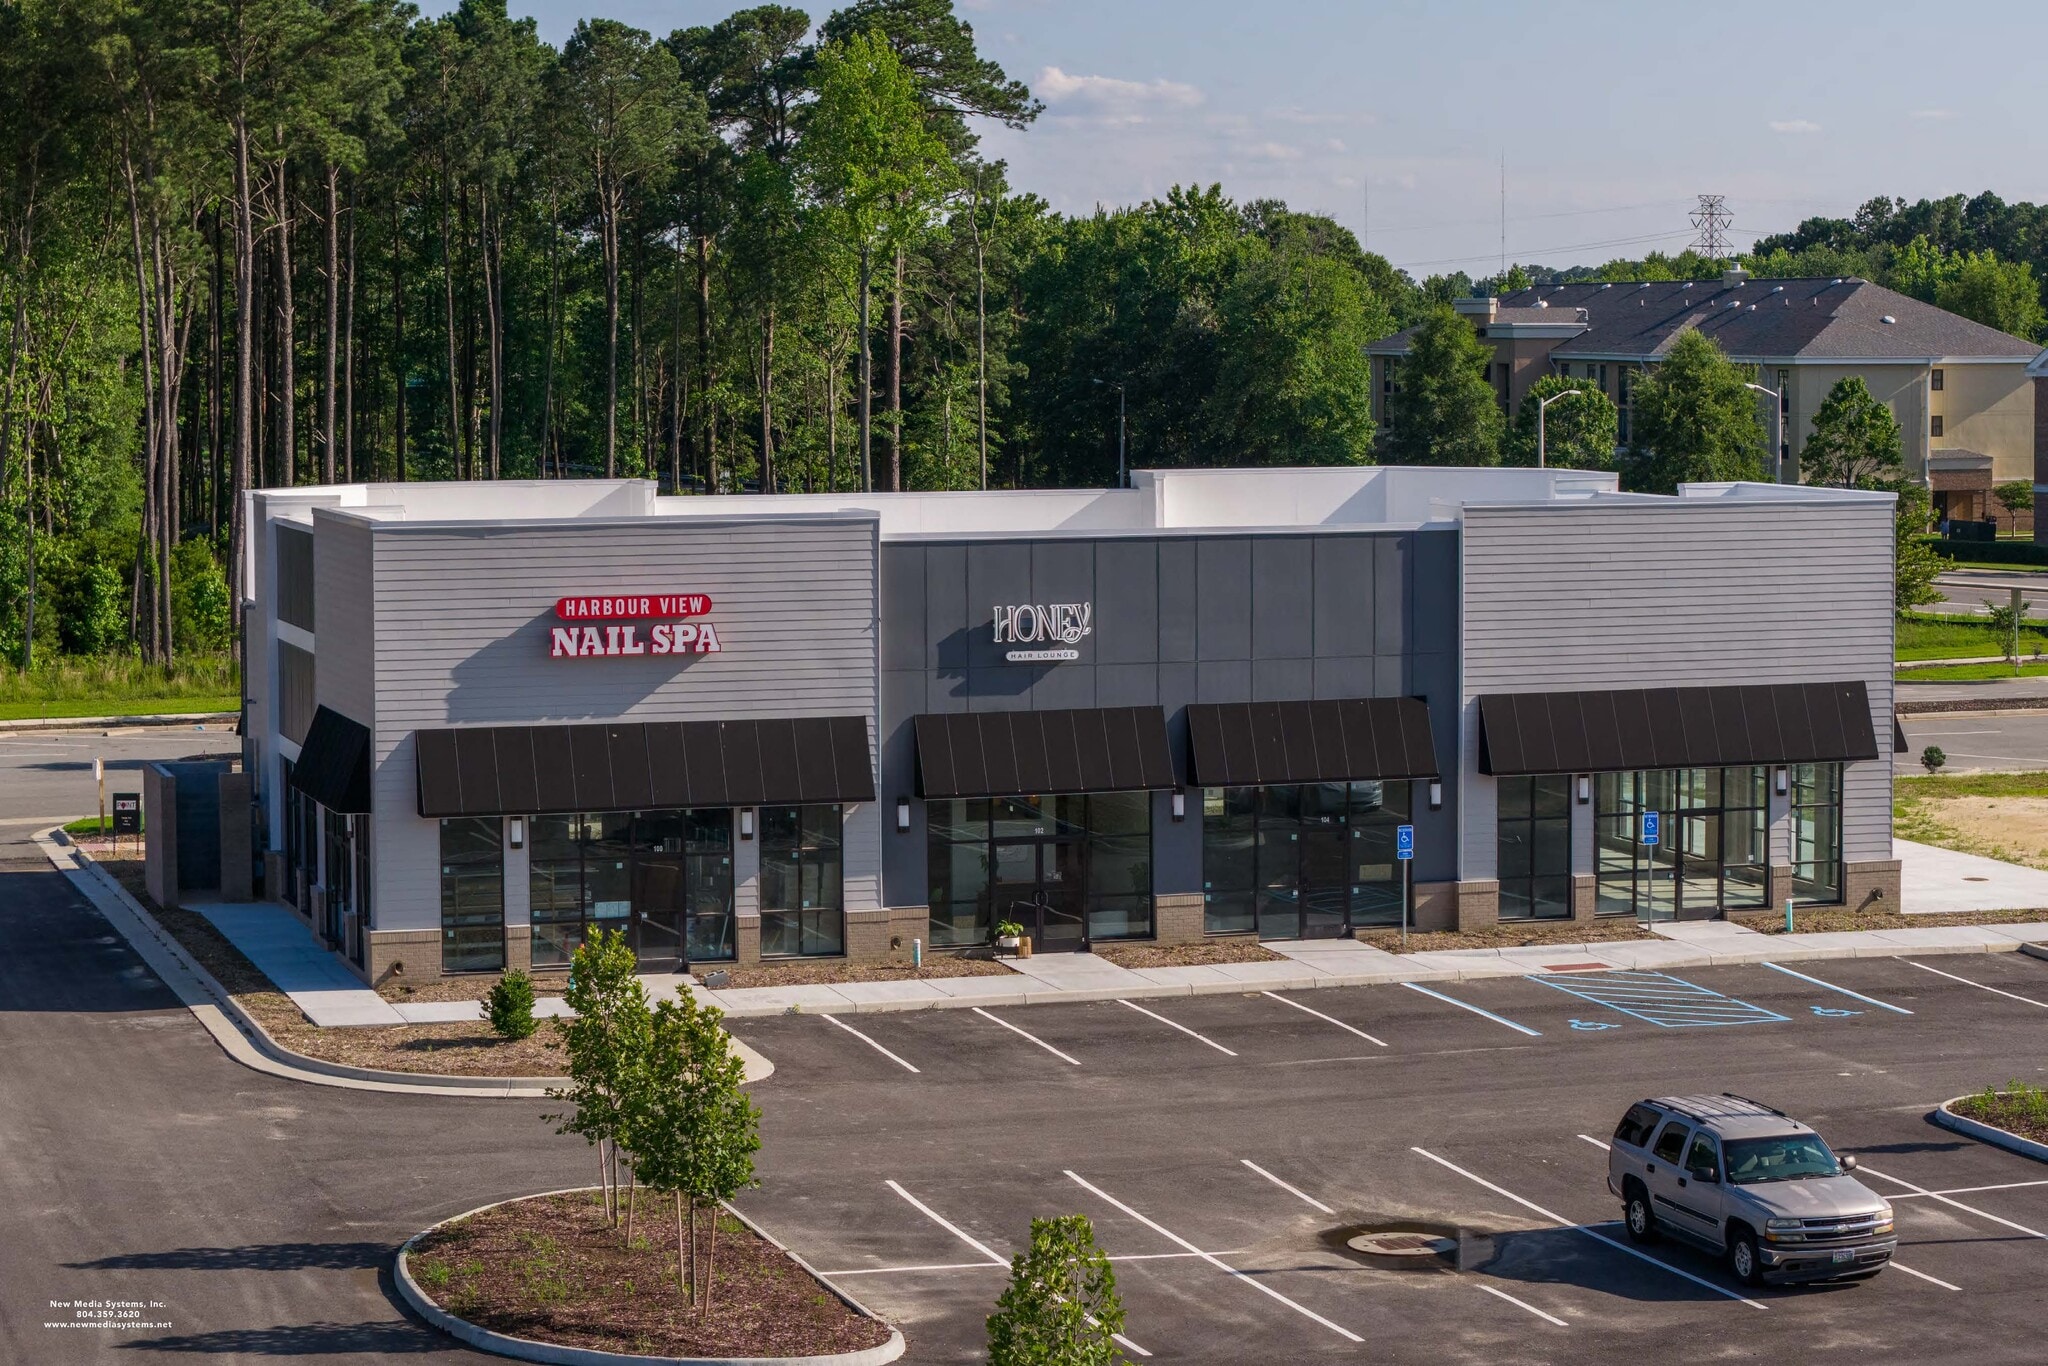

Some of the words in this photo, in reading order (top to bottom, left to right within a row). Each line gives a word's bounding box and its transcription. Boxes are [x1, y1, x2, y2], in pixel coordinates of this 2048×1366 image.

[565, 598, 650, 617] HARBOUR
[659, 596, 703, 614] VIEW
[993, 601, 1092, 644] HONEY
[551, 624, 645, 657] NAIL
[651, 622, 722, 654] SPA
[1037, 651, 1075, 659] LOUNGE
